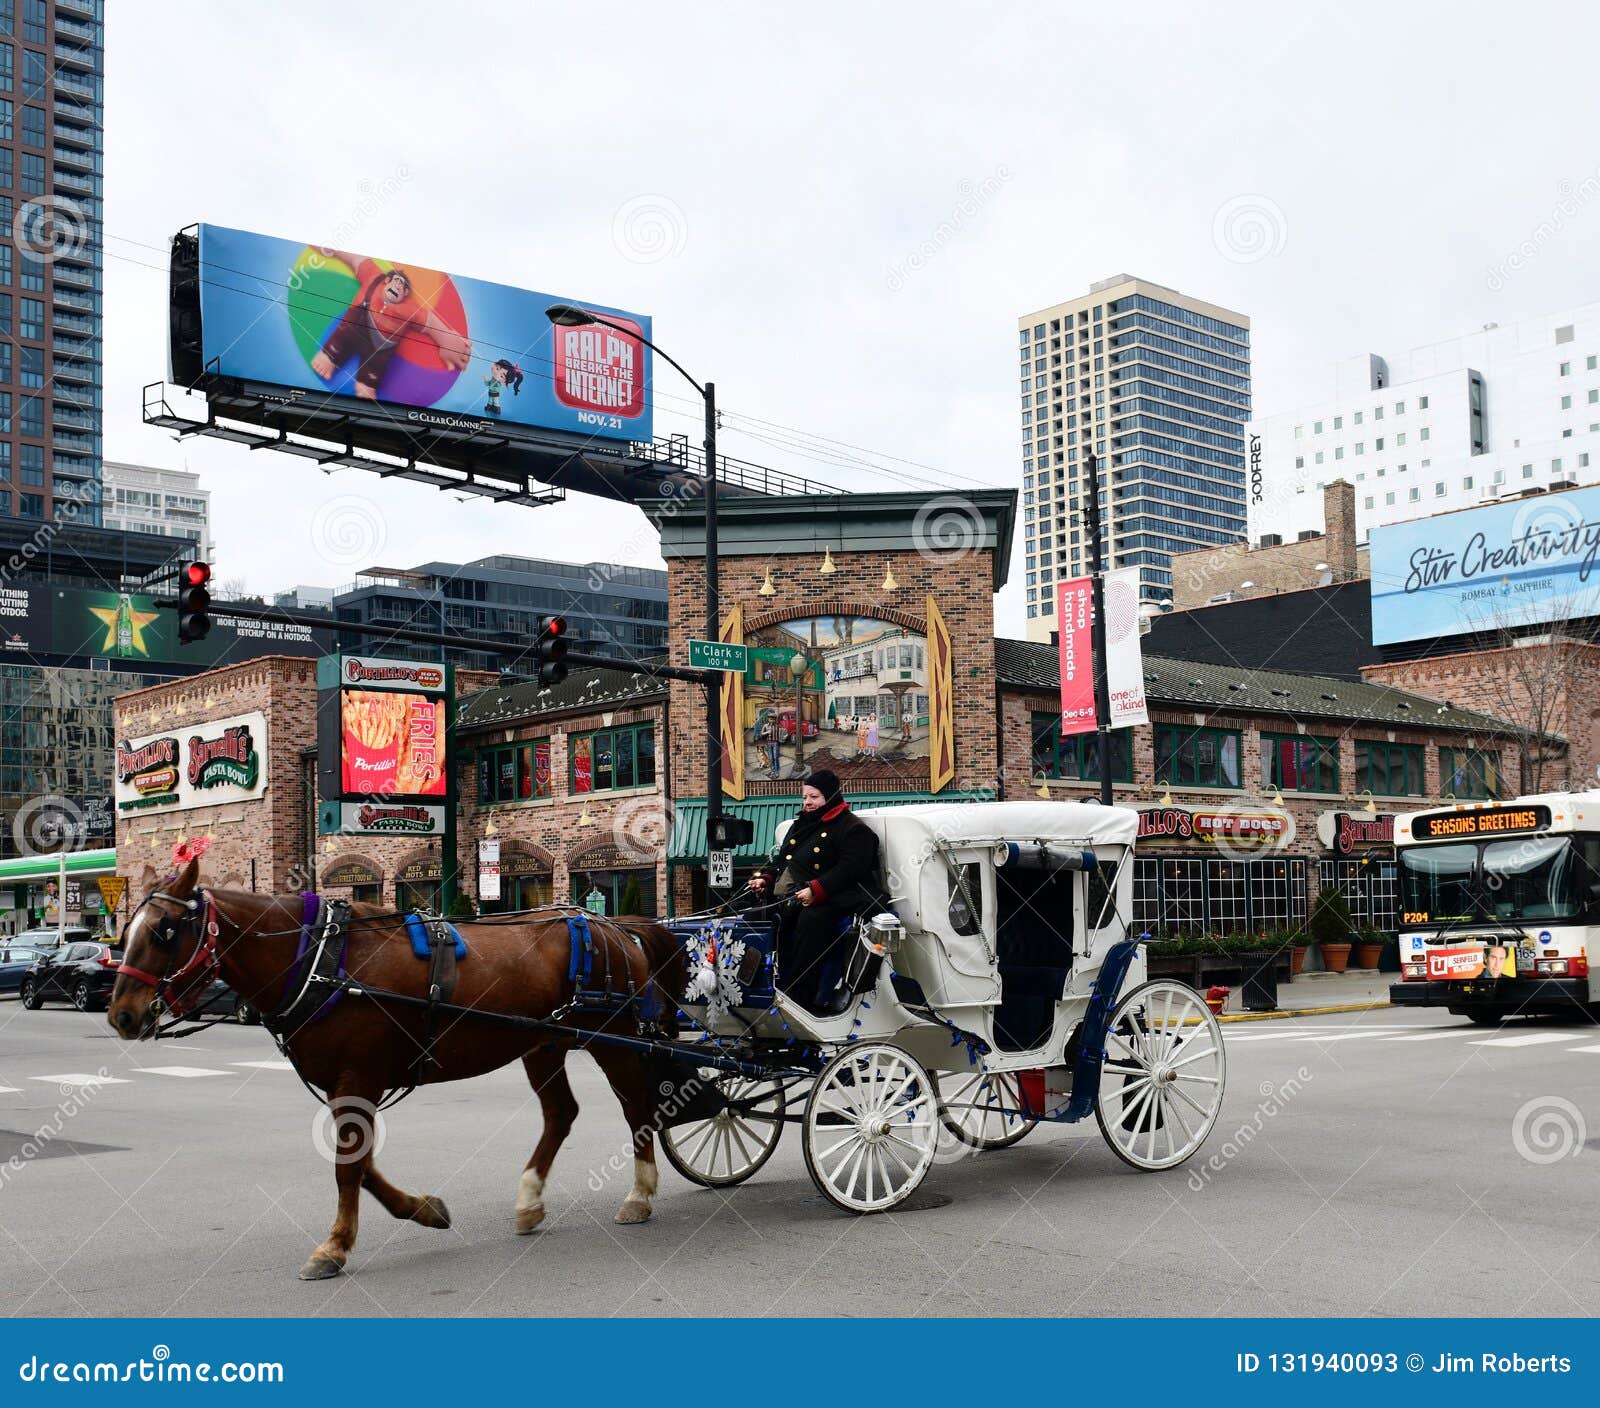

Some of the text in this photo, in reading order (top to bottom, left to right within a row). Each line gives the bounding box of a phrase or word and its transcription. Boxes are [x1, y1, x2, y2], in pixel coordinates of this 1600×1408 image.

[565, 331, 633, 369] RALPH
[566, 357, 633, 380] BREAKS THE
[565, 368, 633, 407] INTERNET
[578, 412, 622, 429] NOV. 21
[1404, 519, 1600, 594] Stir Creativity
[1461, 579, 1553, 602] BOMBAY SAPPHIRE
[1077, 588, 1088, 628] shop
[217, 618, 312, 634] MORE WOULD BE LIKE PUTTING
[237, 628, 265, 638] KETCHUP
[266, 630, 277, 638] ON
[278, 631, 283, 639] A
[1065, 591, 1076, 681] handmade
[695, 645, 742, 659] N Clark St
[708, 658, 720, 666] 100
[1063, 710, 1078, 718] Dec
[410, 701, 435, 780] FRIES
[135, 776, 149, 786] HOT
[204, 765, 249, 785] PASTA BOWL
[379, 818, 429, 831] PASTA BOWL
[1200, 817, 1282, 830] HOT DOGS
[1430, 811, 1536, 836] SEASONS GREETINGS
[712, 853, 729, 863] ONE
[712, 863, 730, 872] WAY
[67, 892, 80, 903] $1
[1403, 912, 1428, 923] P204
